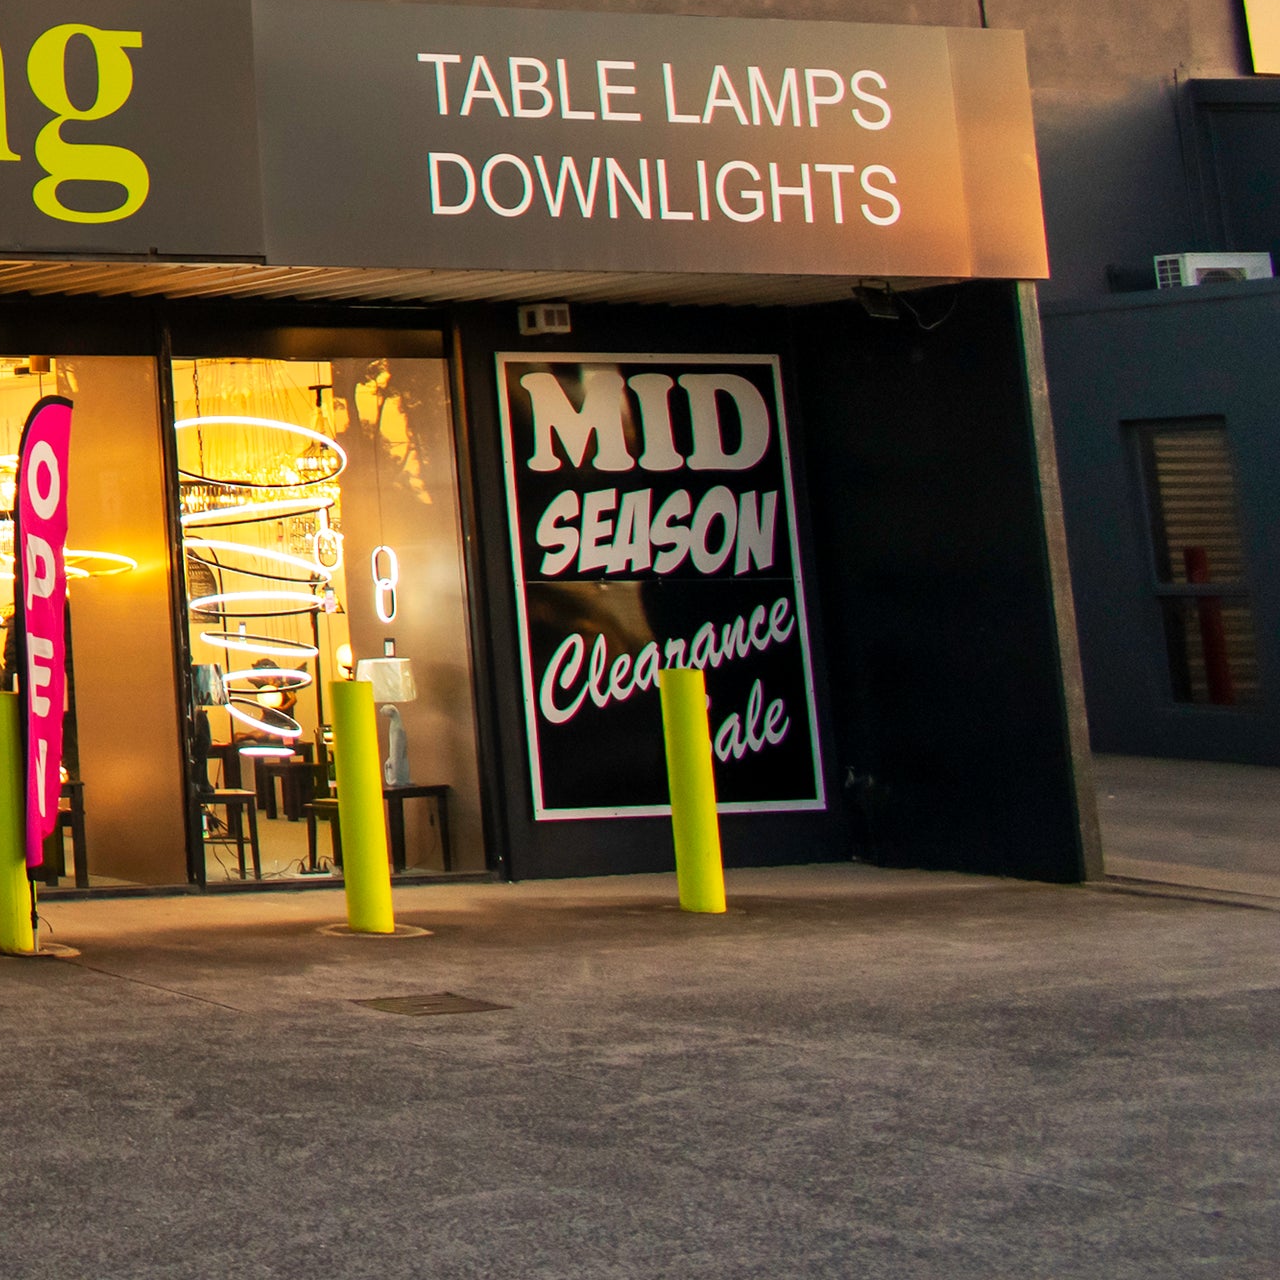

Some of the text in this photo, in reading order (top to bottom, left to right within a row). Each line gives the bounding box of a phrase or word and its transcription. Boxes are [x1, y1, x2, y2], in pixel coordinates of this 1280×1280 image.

[417, 53, 893, 131] TABLE LAMPS
[428, 152, 903, 226] DOWNLIGHTS
[520, 372, 770, 473] MID
[536, 485, 778, 577] SEASON
[540, 597, 795, 724] Clearance
[706, 678, 790, 762] ale
